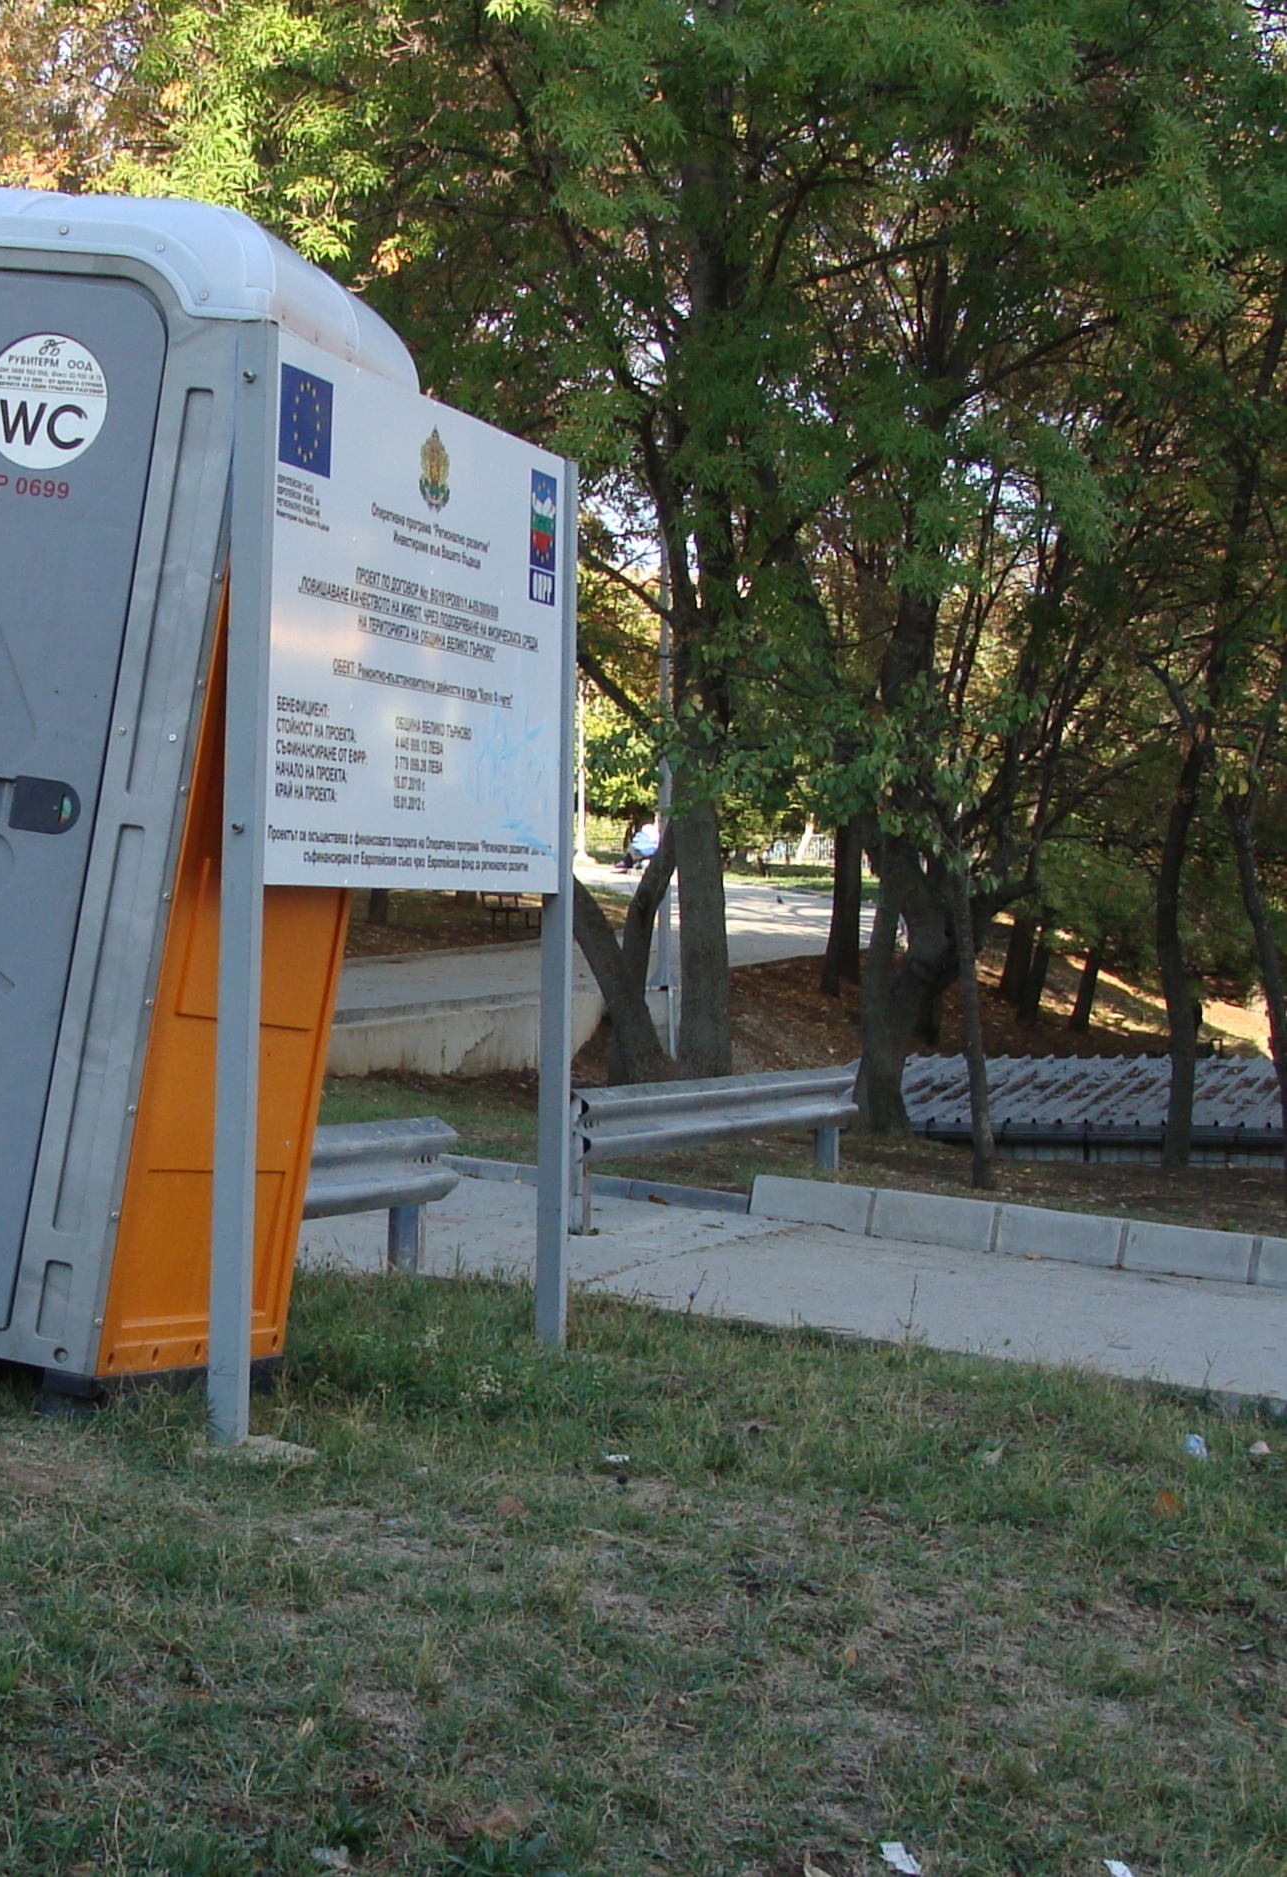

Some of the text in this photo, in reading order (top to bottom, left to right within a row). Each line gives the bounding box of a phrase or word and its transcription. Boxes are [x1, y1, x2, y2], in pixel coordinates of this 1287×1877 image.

[8, 355, 59, 368] РУБИТЕРМ
[0, 399, 88, 450] WC
[16, 477, 69, 498] 0699
[356, 566, 419, 596] ПРОЕКТ ПО ДОГОВОР
[391, 601, 400, 614] НА
[358, 615, 367, 629] НА
[411, 630, 419, 643] НА
[276, 717, 313, 736] СТОЙНОСТ
[315, 725, 323, 737] НА
[276, 739, 337, 761] СЪФИНАНСИРАНЕ
[338, 748, 347, 762] ОТ
[276, 762, 303, 778] НАЧАЛО
[305, 766, 314, 778] НА
[275, 782, 292, 798] КРАЙ
[294, 786, 303, 799] НА
